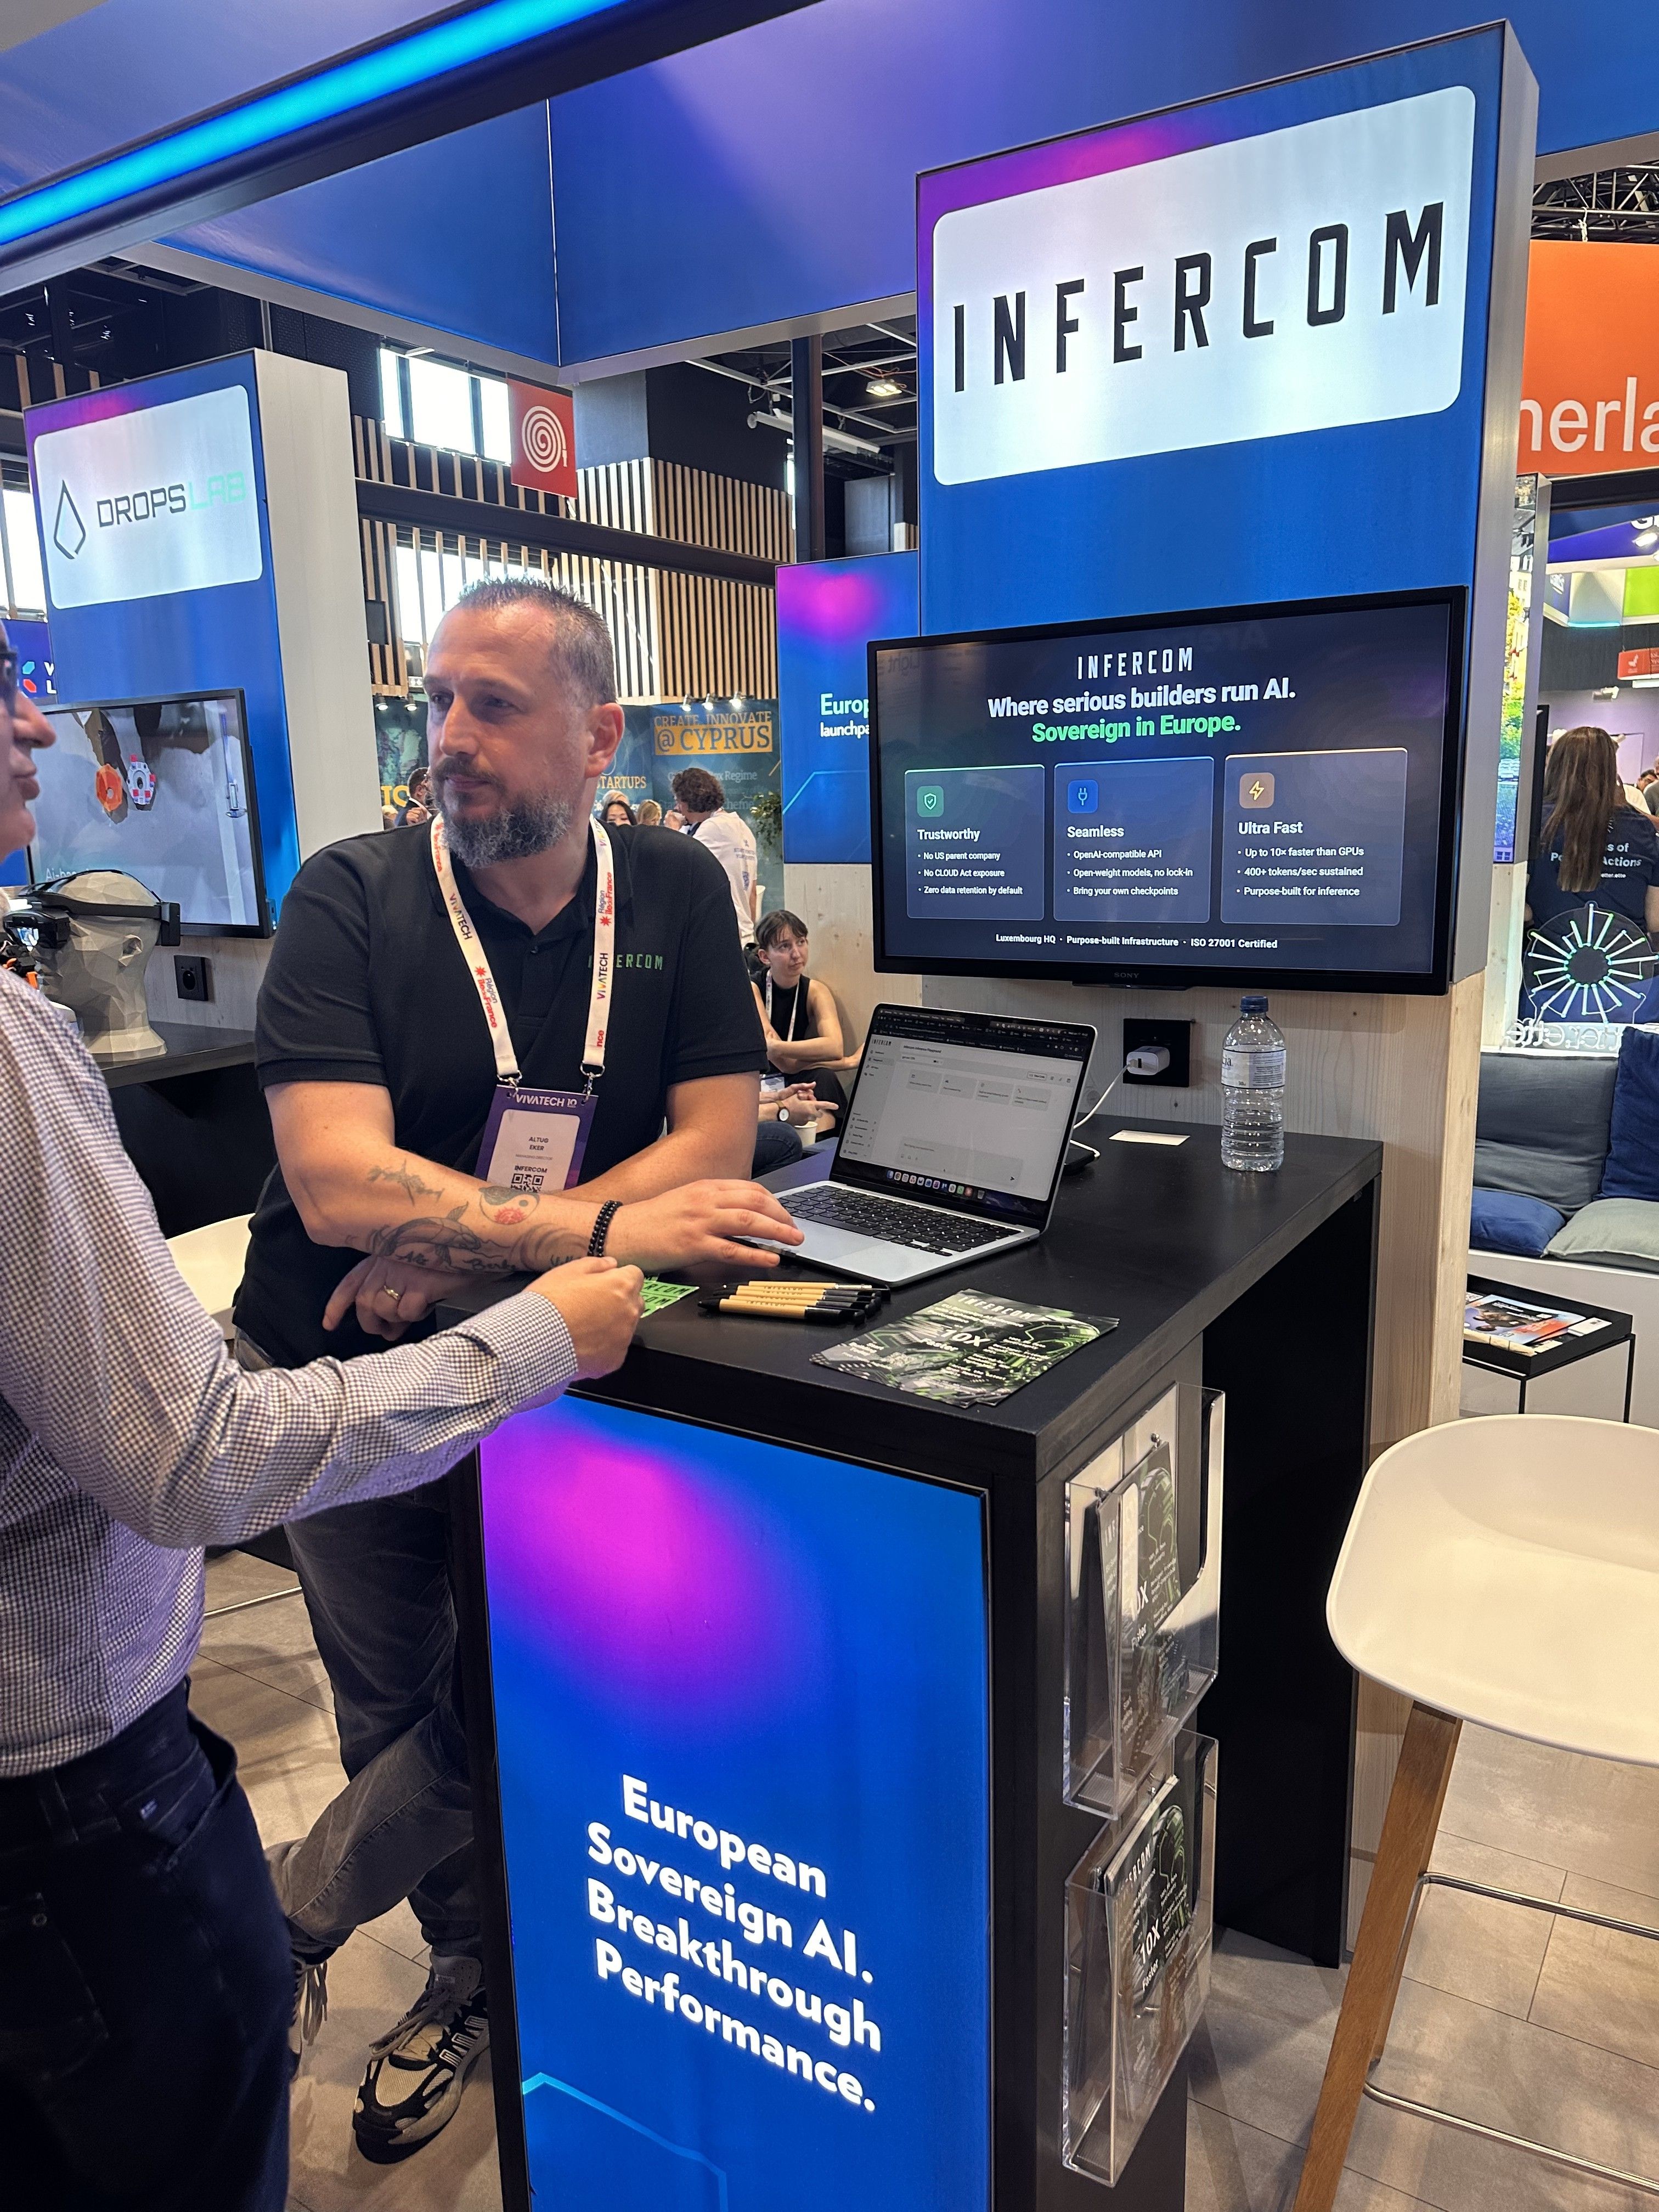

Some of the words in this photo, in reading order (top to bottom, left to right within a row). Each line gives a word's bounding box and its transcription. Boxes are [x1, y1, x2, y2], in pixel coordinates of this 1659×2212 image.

[953, 201, 1444, 393] INFERCOM
[1077, 647, 1193, 680] INFERCOM
[988, 698, 1048, 718] Where
[1052, 691, 1126, 713] serious
[1131, 684, 1216, 708] builders
[1222, 684, 1258, 702] run
[1263, 678, 1296, 699] AI.
[706, 711, 771, 724] INNOVATE
[1032, 718, 1130, 743] Sovereign
[1136, 716, 1154, 736] in
[1160, 714, 1241, 738] Europe.
[658, 729, 675, 752] @
[680, 725, 770, 751] CYPRUS
[725, 770, 758, 783] Regime
[917, 828, 980, 842] Trustworthy
[1066, 825, 1124, 838] Seamless
[1238, 822, 1271, 834] Ultra
[1273, 821, 1303, 834] Fast
[1073, 849, 1146, 860] OpenAI-compatible
[1147, 850, 1162, 858] API
[1245, 848, 1257, 858] Up
[1288, 847, 1314, 856] faster
[1316, 847, 1337, 856] than
[1338, 847, 1364, 856] GPUs
[1616, 843, 1629, 853] of
[945, 853, 967, 861] parent
[968, 852, 1000, 862] company
[973, 870, 1005, 878] exposure
[1073, 868, 1121, 878] Open-weight
[1122, 868, 1152, 878] models,
[1166, 867, 1193, 877] lock-in
[1244, 867, 1267, 876] 400+
[1267, 867, 1317, 877] tokens/sec
[1319, 867, 1363, 876] sustained
[956, 886, 987, 894] retention
[988, 887, 997, 896] by
[998, 885, 1023, 895] default
[1073, 887, 1093, 896] Bring
[1094, 888, 1111, 896] your
[1130, 887, 1178, 896] checkpoints
[1244, 887, 1301, 897] Purpose-built
[1302, 887, 1316, 896] for
[1317, 887, 1359, 896] inference
[449, 893, 472, 940] VIVATECH
[996, 934, 1042, 945] Luxembourg
[1043, 935, 1056, 944] HQ
[1066, 935, 1120, 946] Purpose-built
[1121, 936, 1178, 946] Infrastructure
[1190, 938, 1206, 947] ISO
[1208, 938, 1235, 948] 27001
[1238, 939, 1278, 949] Certified
[588, 953, 663, 970] IERCOM
[597, 952, 608, 1000] VIVATECH
[516, 1094, 565, 1107] VIVATECH
[644, 1284, 691, 1295] RCOM
[958, 1296, 1035, 1319] INFERCOM
[940, 1329, 991, 1347] 10X
[622, 1773, 826, 1897] European
[1127, 1843, 1151, 1883] ERCOM
[588, 1821, 793, 1944] Sovereign
[803, 1918, 874, 1984] AI.
[1140, 1918, 1160, 1964] 10X
[588, 1878, 881, 2051] Breakthrough
[1142, 1958, 1159, 1991] Faster
[595, 1938, 875, 2111] Performance.
